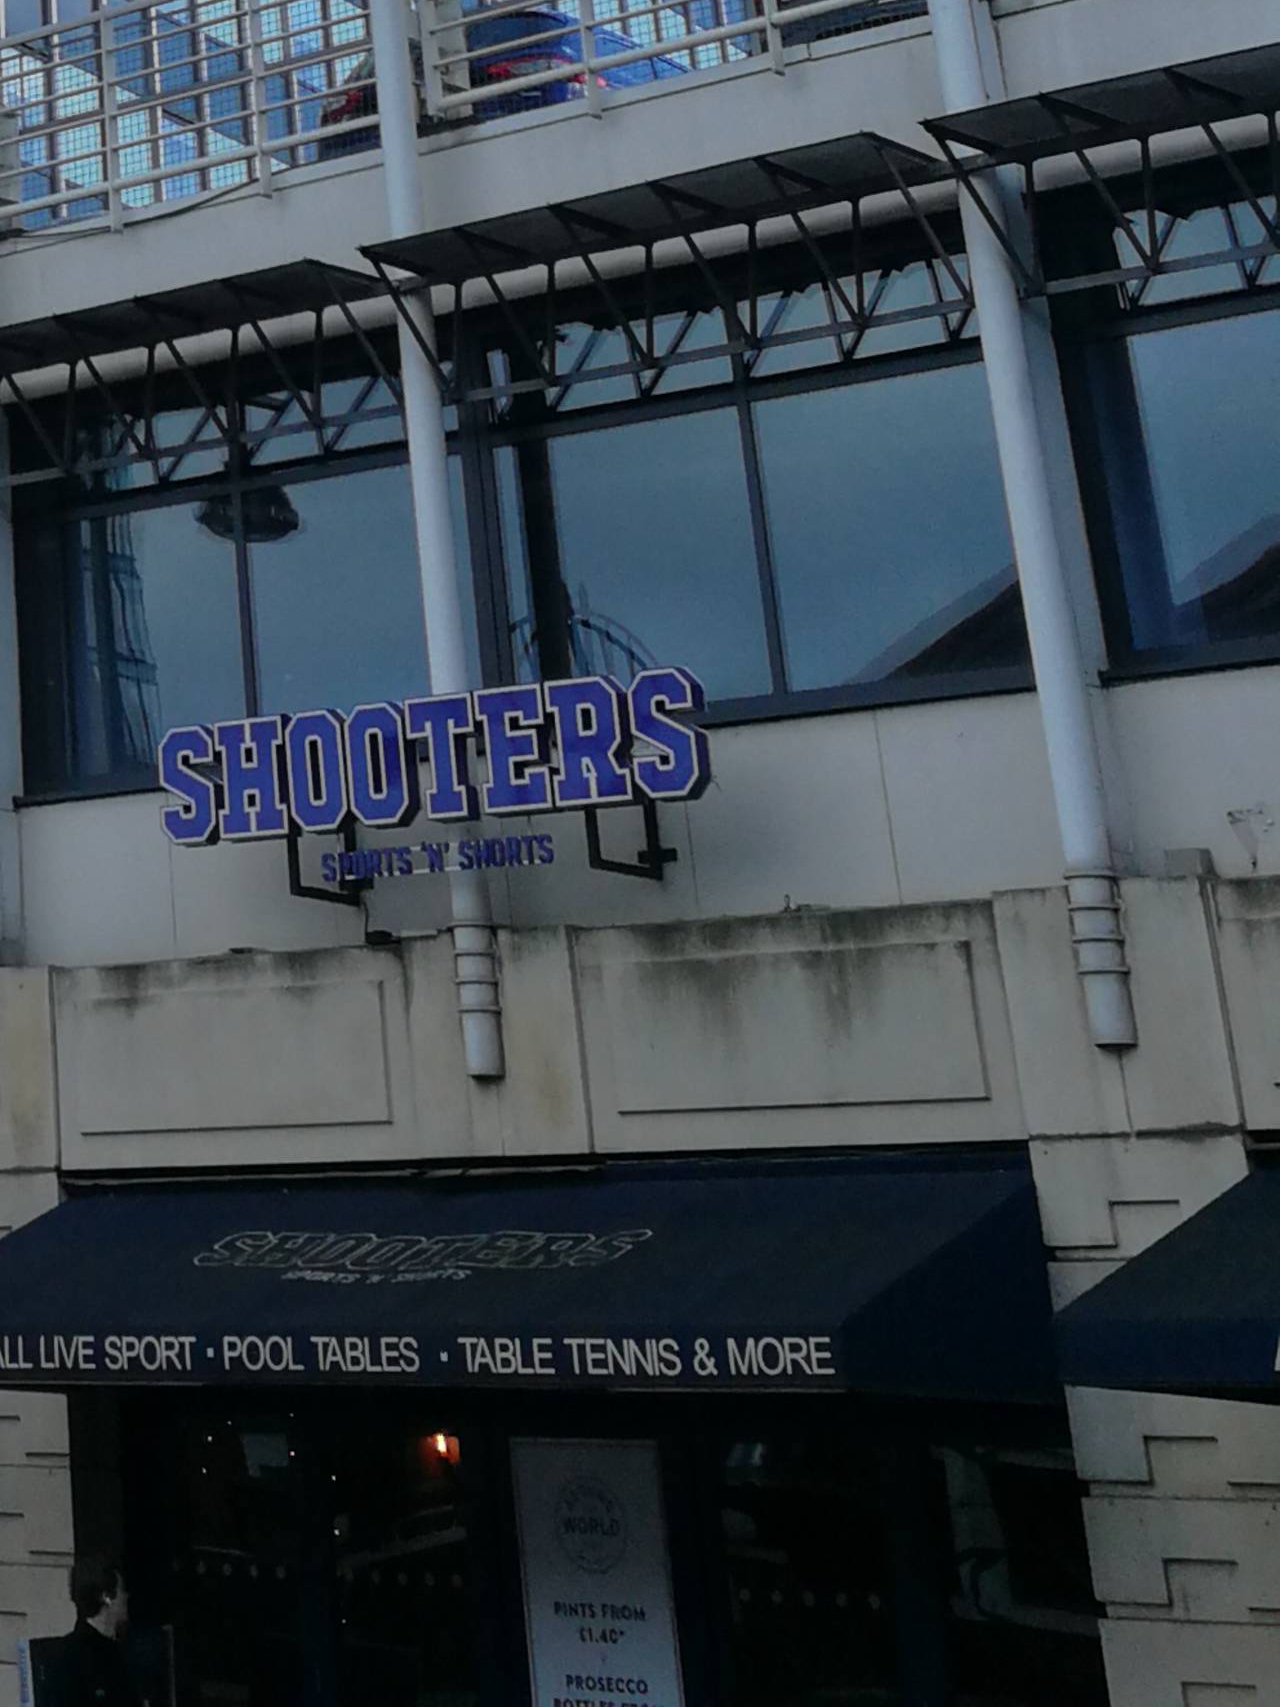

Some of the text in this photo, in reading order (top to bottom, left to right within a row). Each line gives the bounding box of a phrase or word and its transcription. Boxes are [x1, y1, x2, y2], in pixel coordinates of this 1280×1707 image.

[157, 666, 710, 845] SHOOTERS
[321, 846, 413, 883] SPORTS
[457, 834, 555, 872] SHORTS
[193, 1228, 654, 1270] SHOOTERS
[39, 1334, 97, 1370] LIVE
[103, 1334, 198, 1371] SPORT
[222, 1335, 305, 1371] POOL
[310, 1335, 420, 1373] TABLES
[457, 1336, 556, 1375] TABLE
[562, 1336, 683, 1377] TENNIS
[692, 1336, 719, 1377] &
[726, 1335, 837, 1376] MORE
[553, 1600, 647, 1622] PINTS FROM
[565, 1674, 649, 1695] PROSECCO
